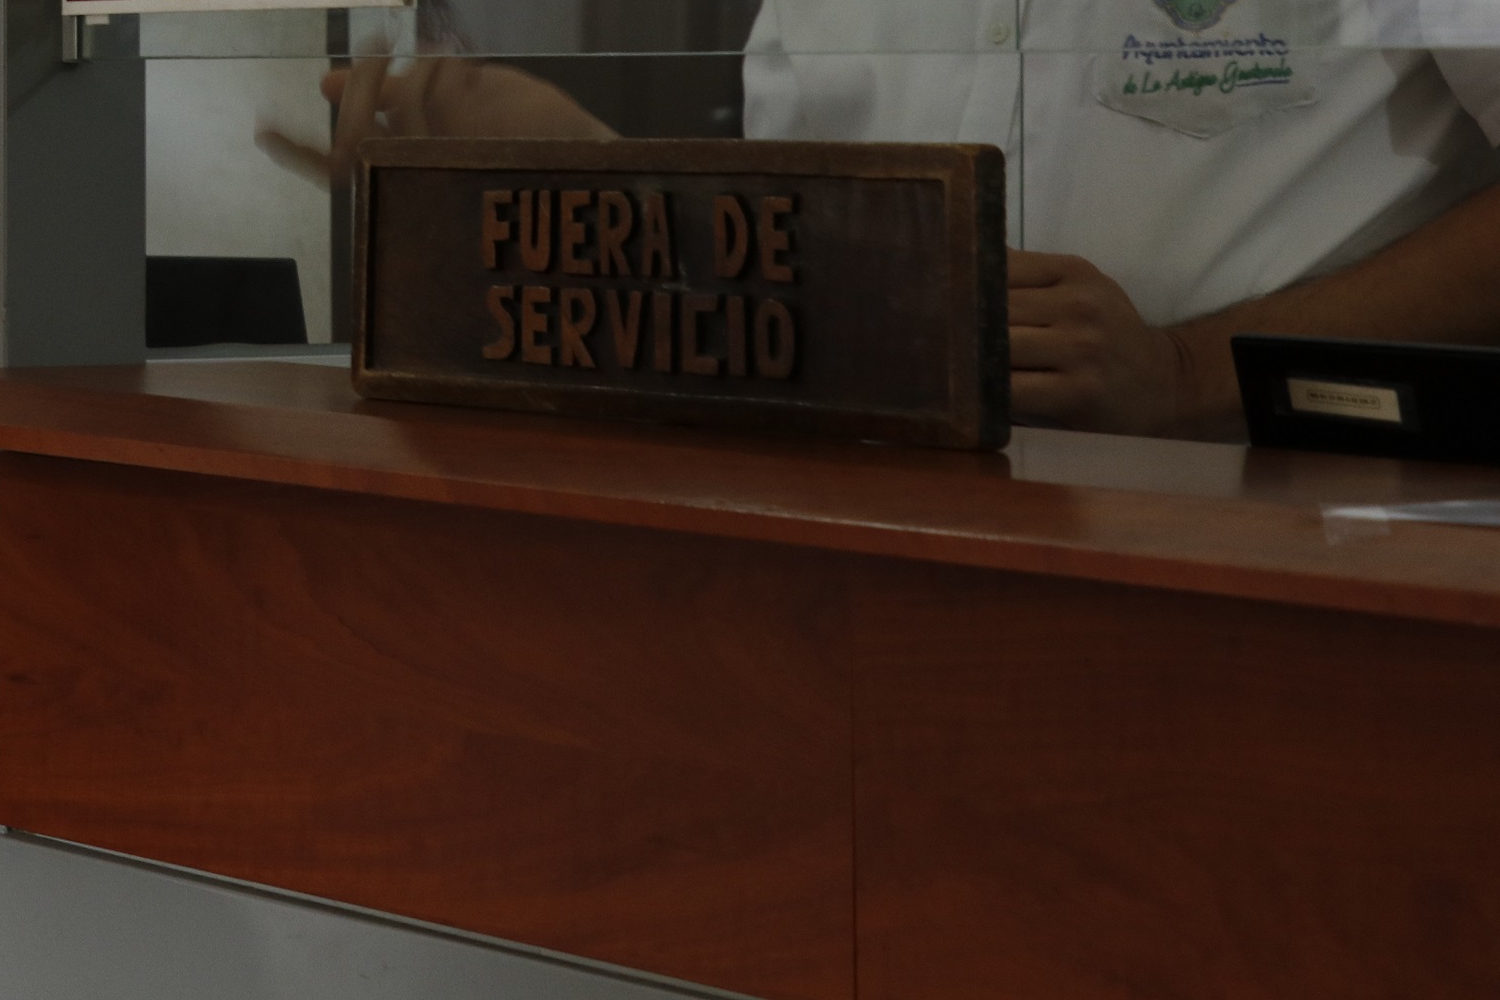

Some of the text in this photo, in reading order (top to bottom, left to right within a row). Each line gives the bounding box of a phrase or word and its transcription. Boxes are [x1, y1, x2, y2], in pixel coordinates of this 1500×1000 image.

[482, 188, 795, 284] FUERA DE
[482, 284, 796, 381] SERVICIO
